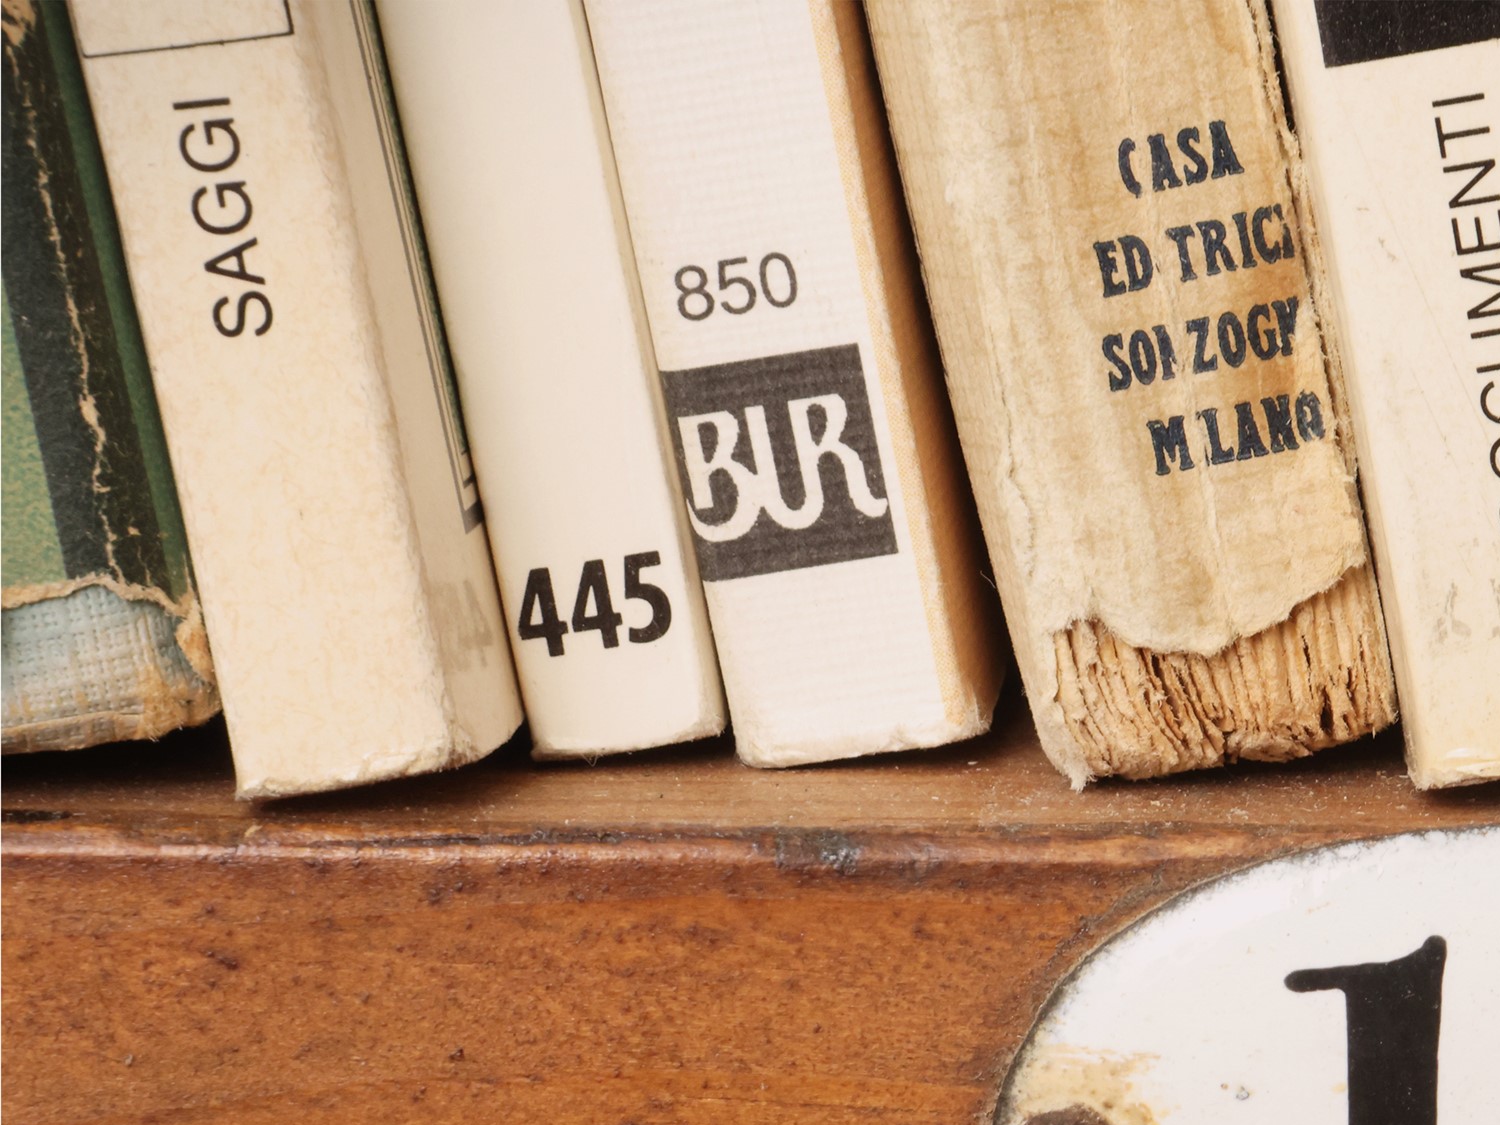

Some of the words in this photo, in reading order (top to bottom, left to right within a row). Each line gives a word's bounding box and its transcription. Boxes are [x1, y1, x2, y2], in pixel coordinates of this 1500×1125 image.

[1118, 120, 1245, 199] CASA
[172, 97, 273, 338] SAGGI
[674, 252, 797, 321] 850
[678, 393, 888, 542] BUR
[1146, 389, 1325, 476] MLANO
[518, 551, 673, 657] 445
